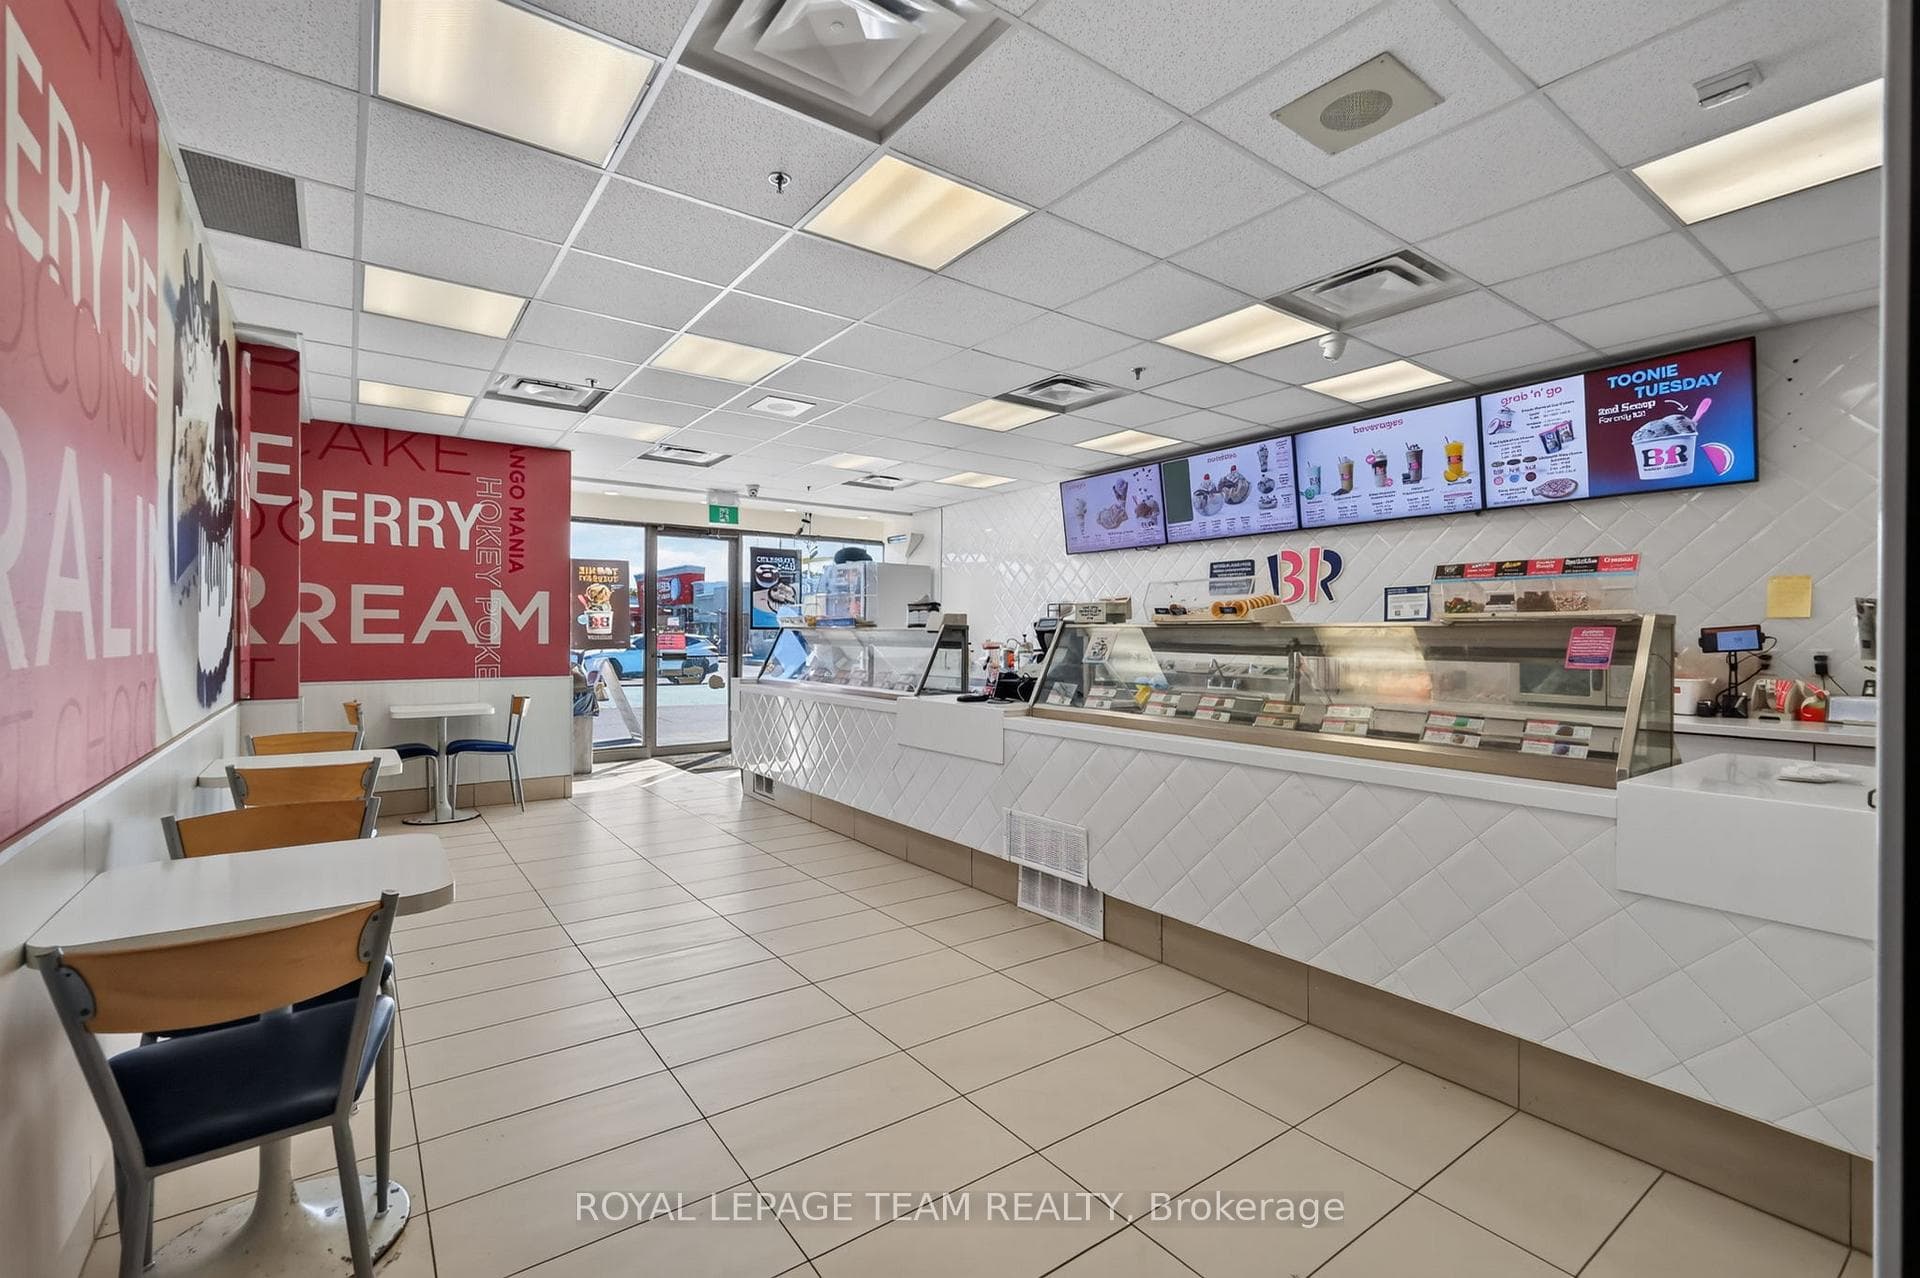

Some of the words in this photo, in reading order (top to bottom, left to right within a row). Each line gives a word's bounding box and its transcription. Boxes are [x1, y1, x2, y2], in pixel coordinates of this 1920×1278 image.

[1501, 391, 1528, 408] grab
[1546, 386, 1562, 398] go
[1607, 364, 1678, 389] TOONIE
[1634, 371, 1723, 399] TUESDAY
[302, 422, 471, 476] AKE
[1353, 418, 1404, 434] beverages
[509, 447, 525, 500] NGO
[1642, 444, 1688, 468] BR
[476, 476, 502, 587] HOKEY
[508, 506, 525, 574] MANIA
[1267, 547, 1343, 604] BR
[475, 596, 501, 680] POKE
